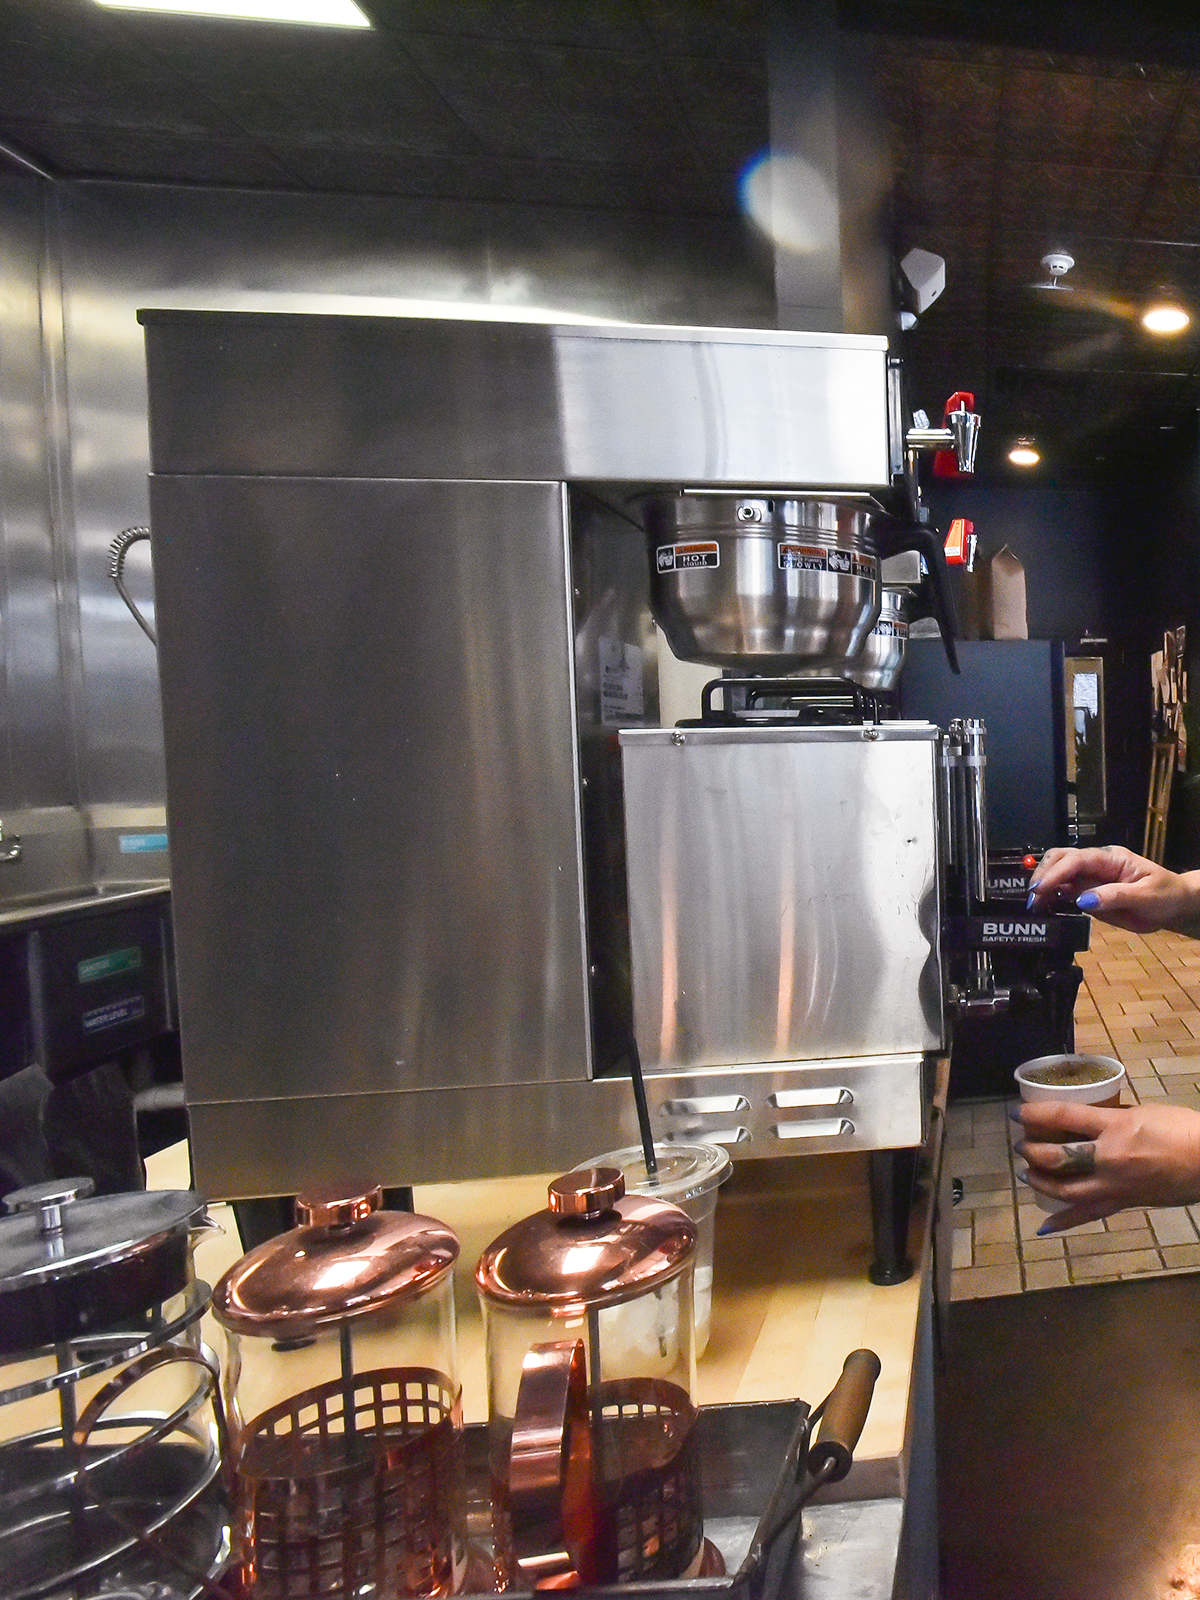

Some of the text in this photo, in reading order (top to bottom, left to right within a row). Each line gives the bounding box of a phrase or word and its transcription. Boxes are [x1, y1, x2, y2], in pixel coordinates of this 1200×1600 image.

[682, 554, 707, 562] HOT
[987, 878, 1025, 888] UNN
[983, 922, 1046, 935] BUNN
